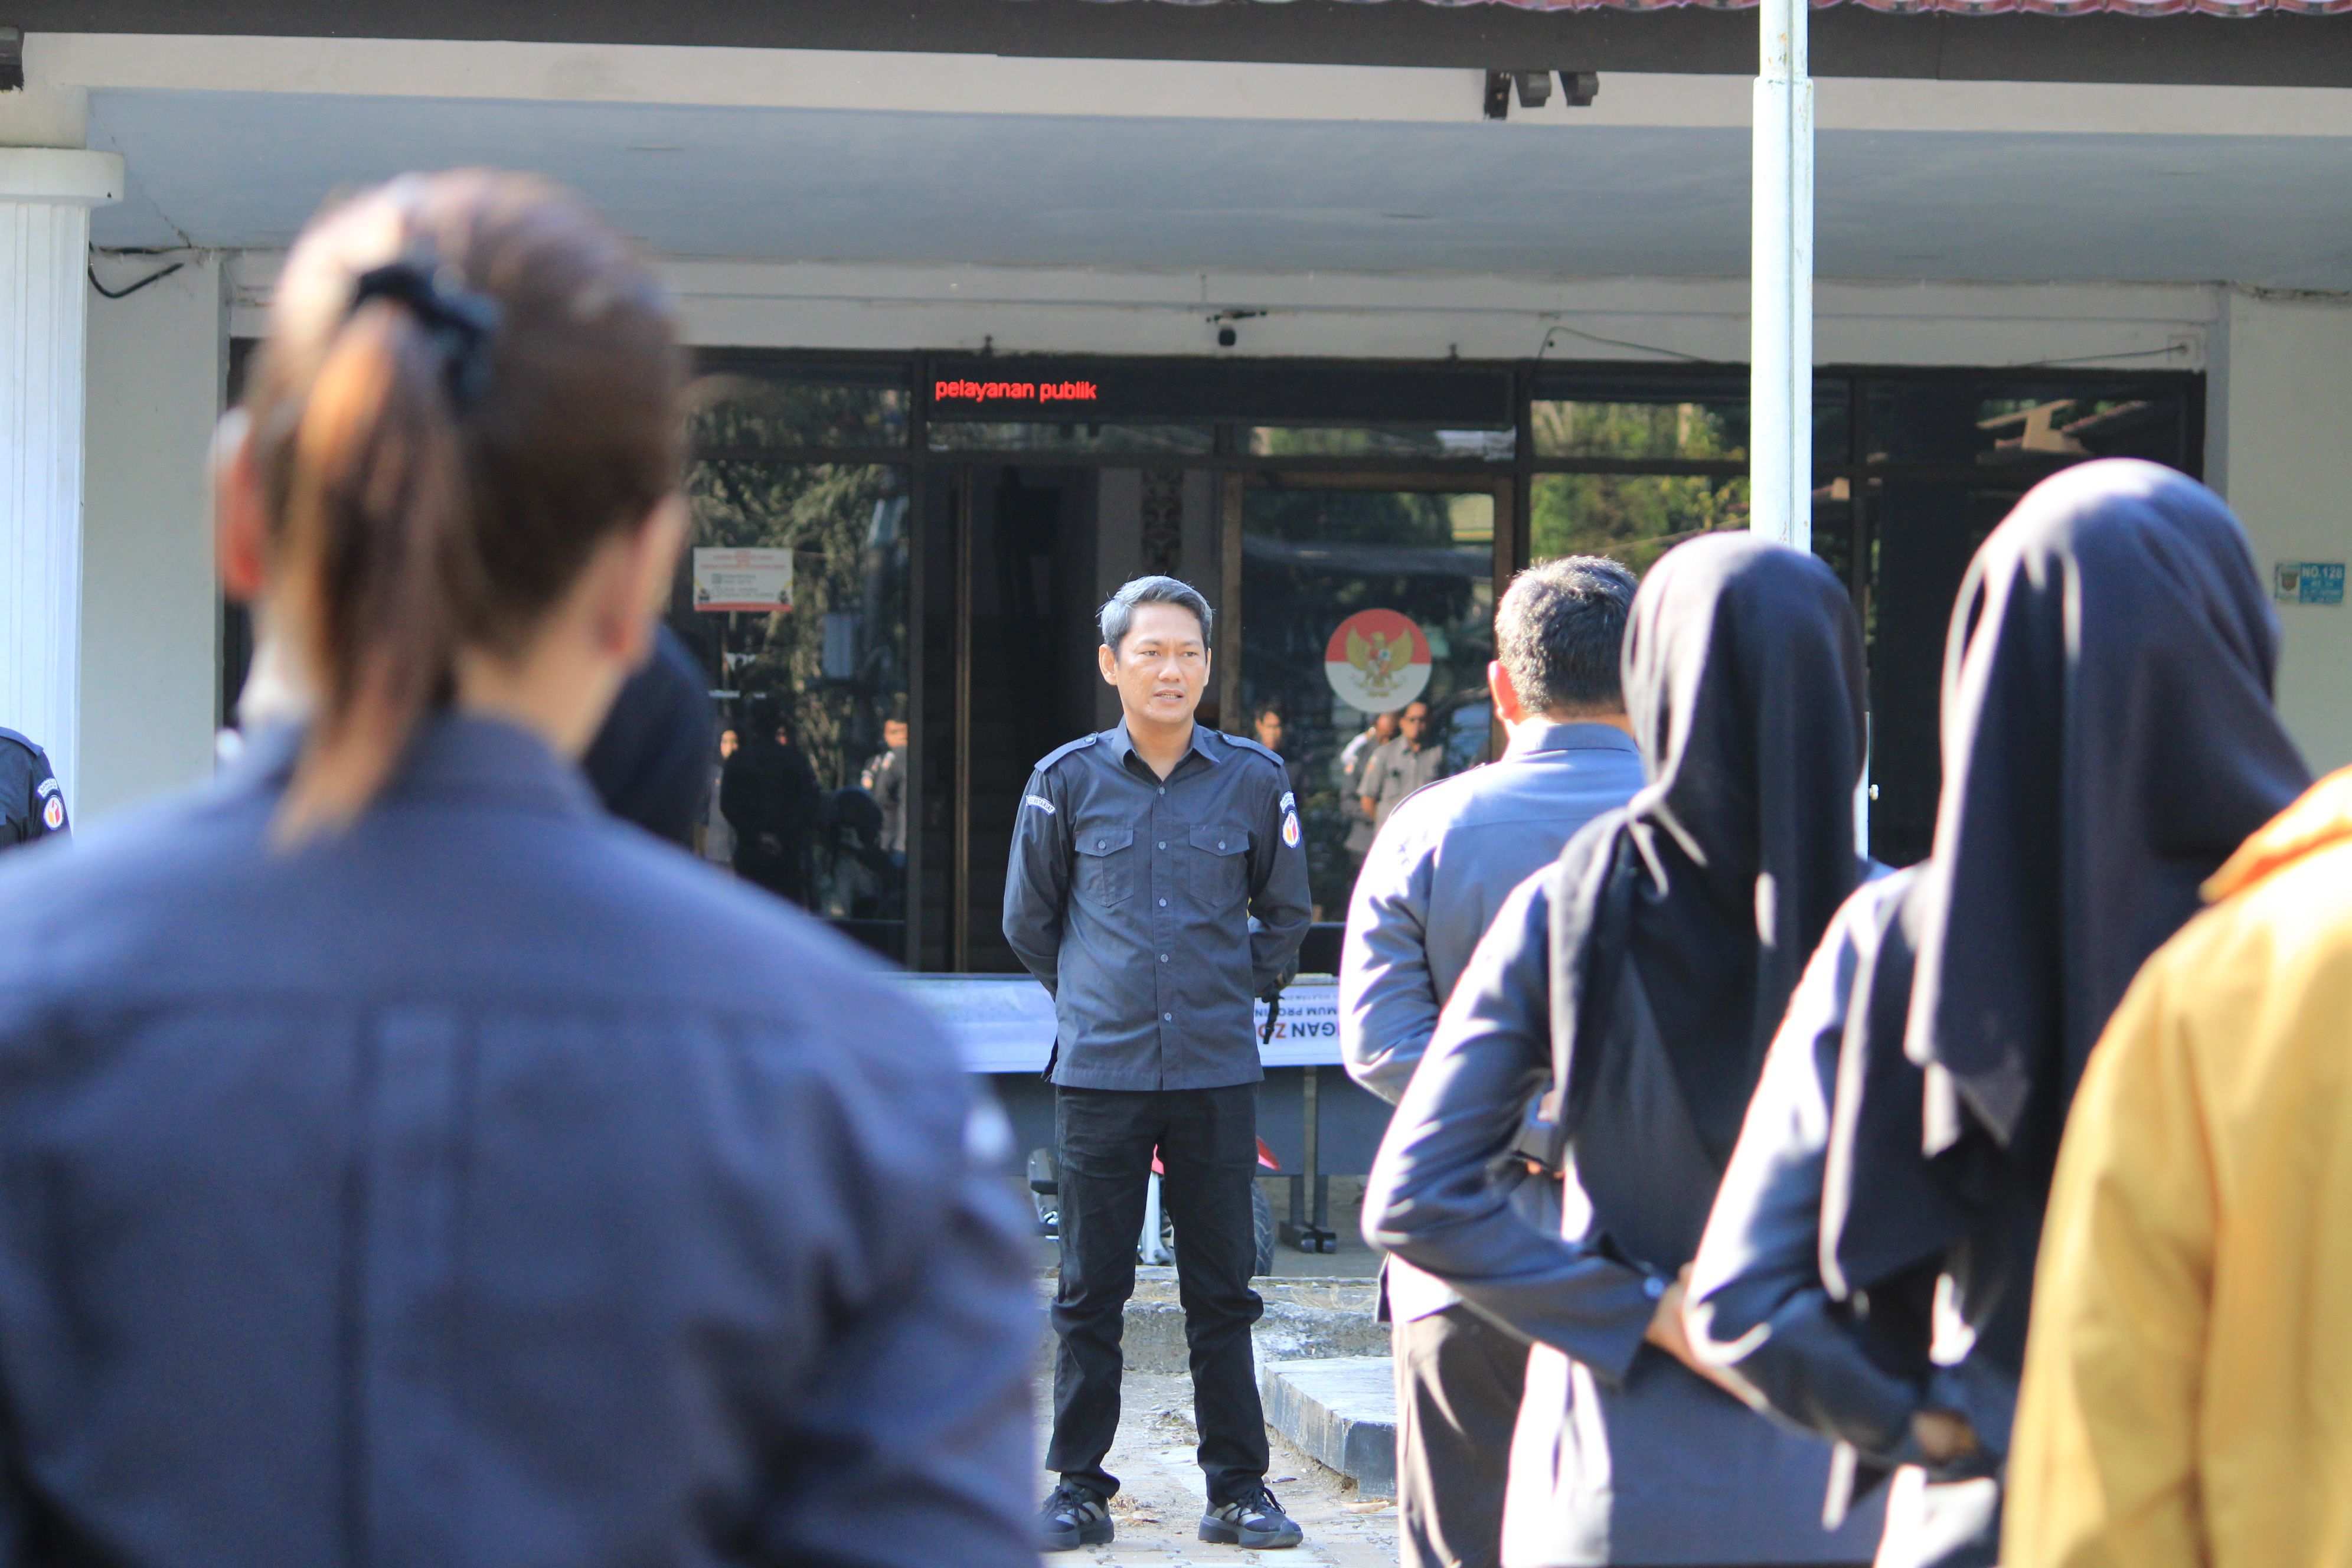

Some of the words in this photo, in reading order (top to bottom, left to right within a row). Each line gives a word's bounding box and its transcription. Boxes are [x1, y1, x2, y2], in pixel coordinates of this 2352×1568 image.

[935, 379, 1034, 403] pelayanan
[1040, 380, 1097, 404] publik
[1291, 1021, 1340, 1038] GAN
